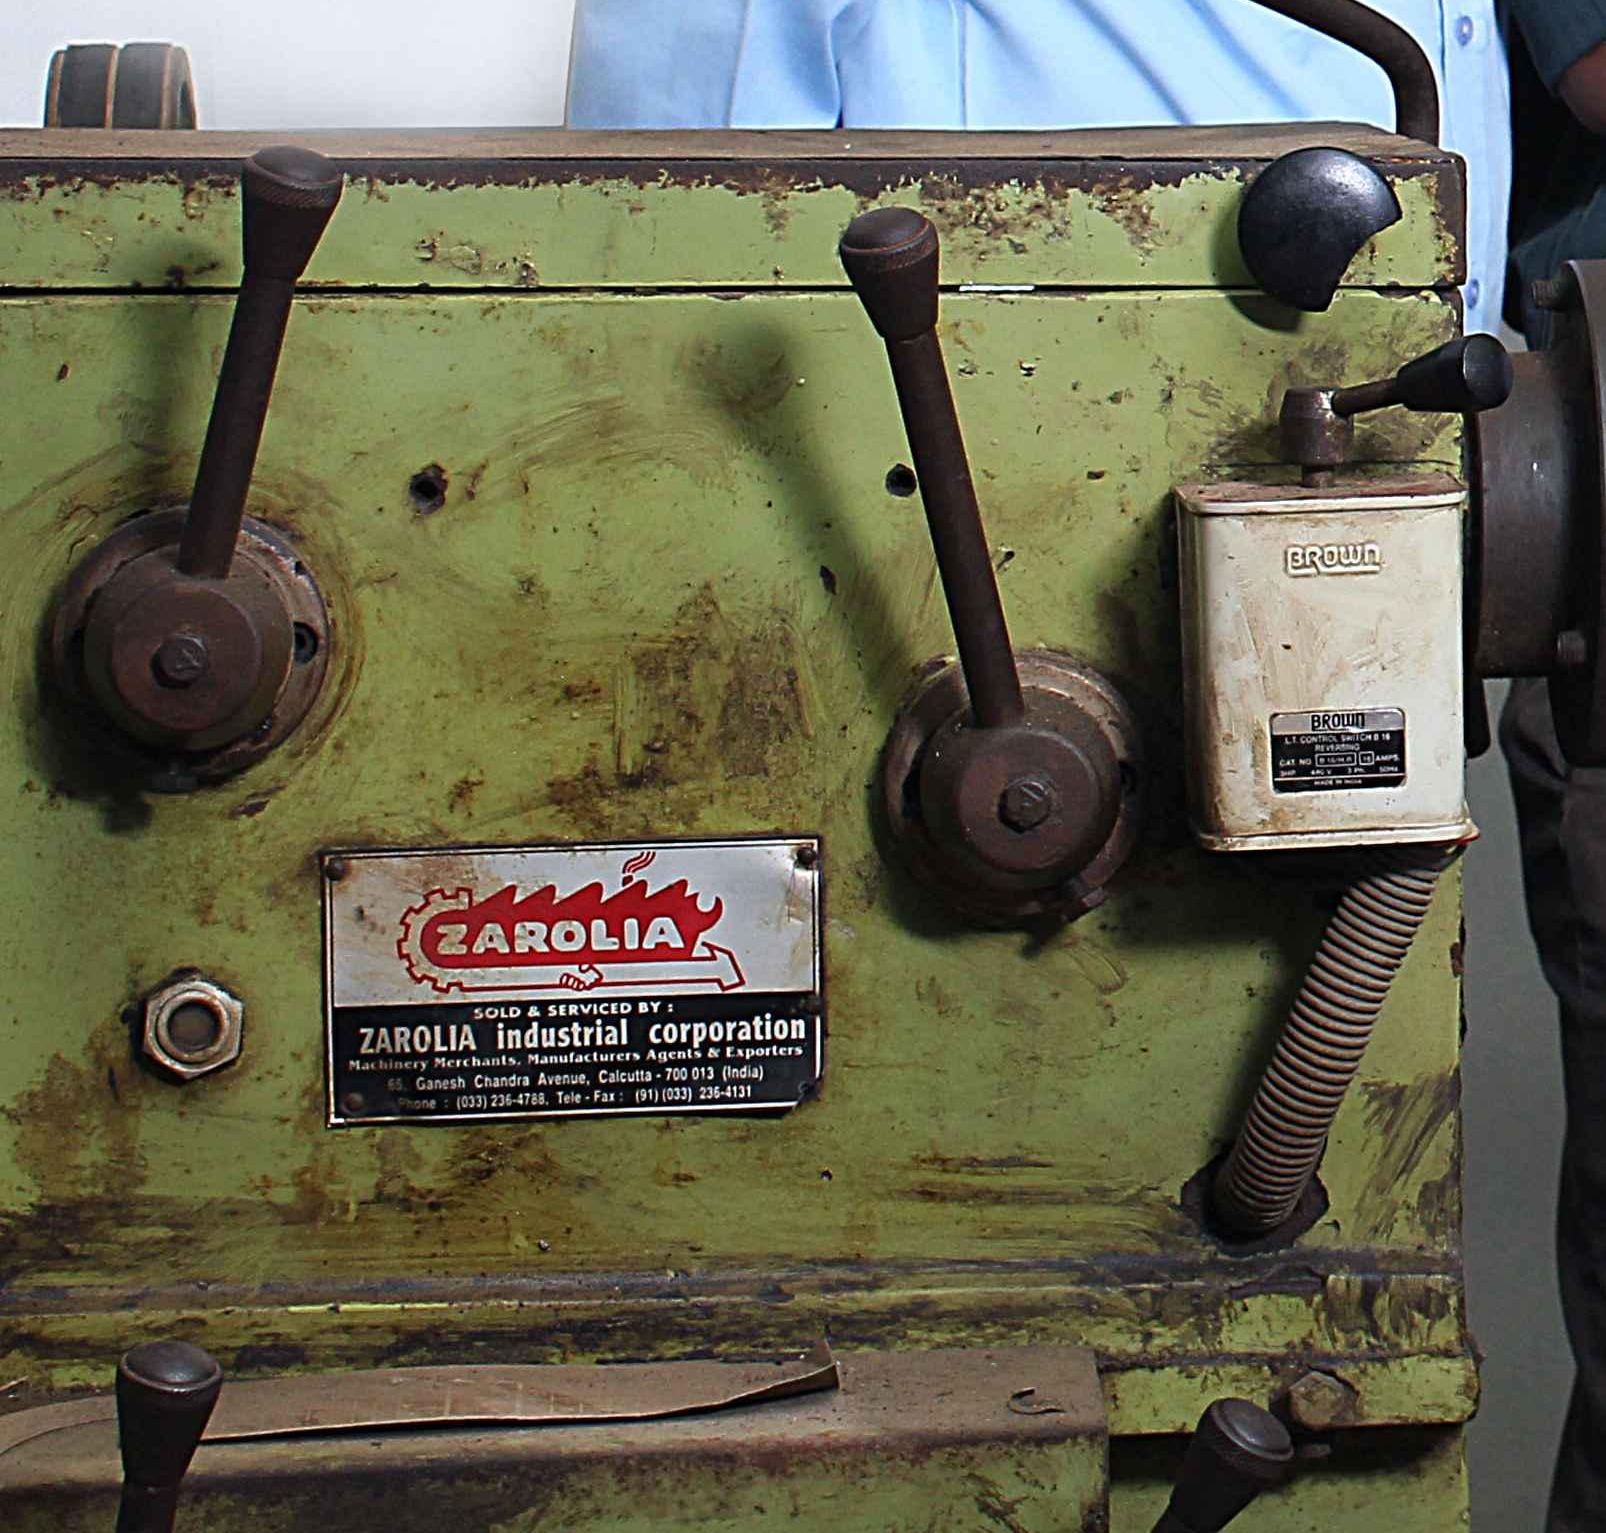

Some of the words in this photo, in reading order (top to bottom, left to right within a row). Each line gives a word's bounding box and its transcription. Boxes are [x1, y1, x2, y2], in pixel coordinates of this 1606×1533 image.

[1300, 734, 1338, 744] CONTROL
[1341, 733, 1372, 742] SWITCH
[436, 916, 685, 955] ZAROLIA
[473, 1006, 521, 1020] SOLD
[527, 1005, 540, 1017] &
[547, 1002, 632, 1017] SERVICED
[638, 1001, 661, 1014] BY
[359, 1023, 477, 1055] ZAROLIA
[496, 1018, 628, 1050] industrial
[649, 1013, 806, 1049] corporation
[349, 1059, 429, 1072] Machinery
[528, 1050, 641, 1066] Manufacturers
[645, 1048, 702, 1064] Agents
[707, 1048, 721, 1059] &
[725, 1044, 803, 1060] Exporters
[416, 1076, 466, 1091] Ganesh
[474, 1072, 529, 1088] Chandra
[537, 1071, 590, 1087] Avenue,
[598, 1068, 652, 1085] Calcutta
[665, 1067, 688, 1081] 700
[691, 1066, 715, 1080] 013
[722, 1065, 764, 1082] (India)
[456, 1094, 487, 1110] (033)
[556, 1091, 582, 1105] Tele
[594, 1089, 616, 1103] Fax
[635, 1087, 659, 1103] (91)
[662, 1086, 693, 1102] (033)
[699, 1085, 751, 1100] 236-4131
